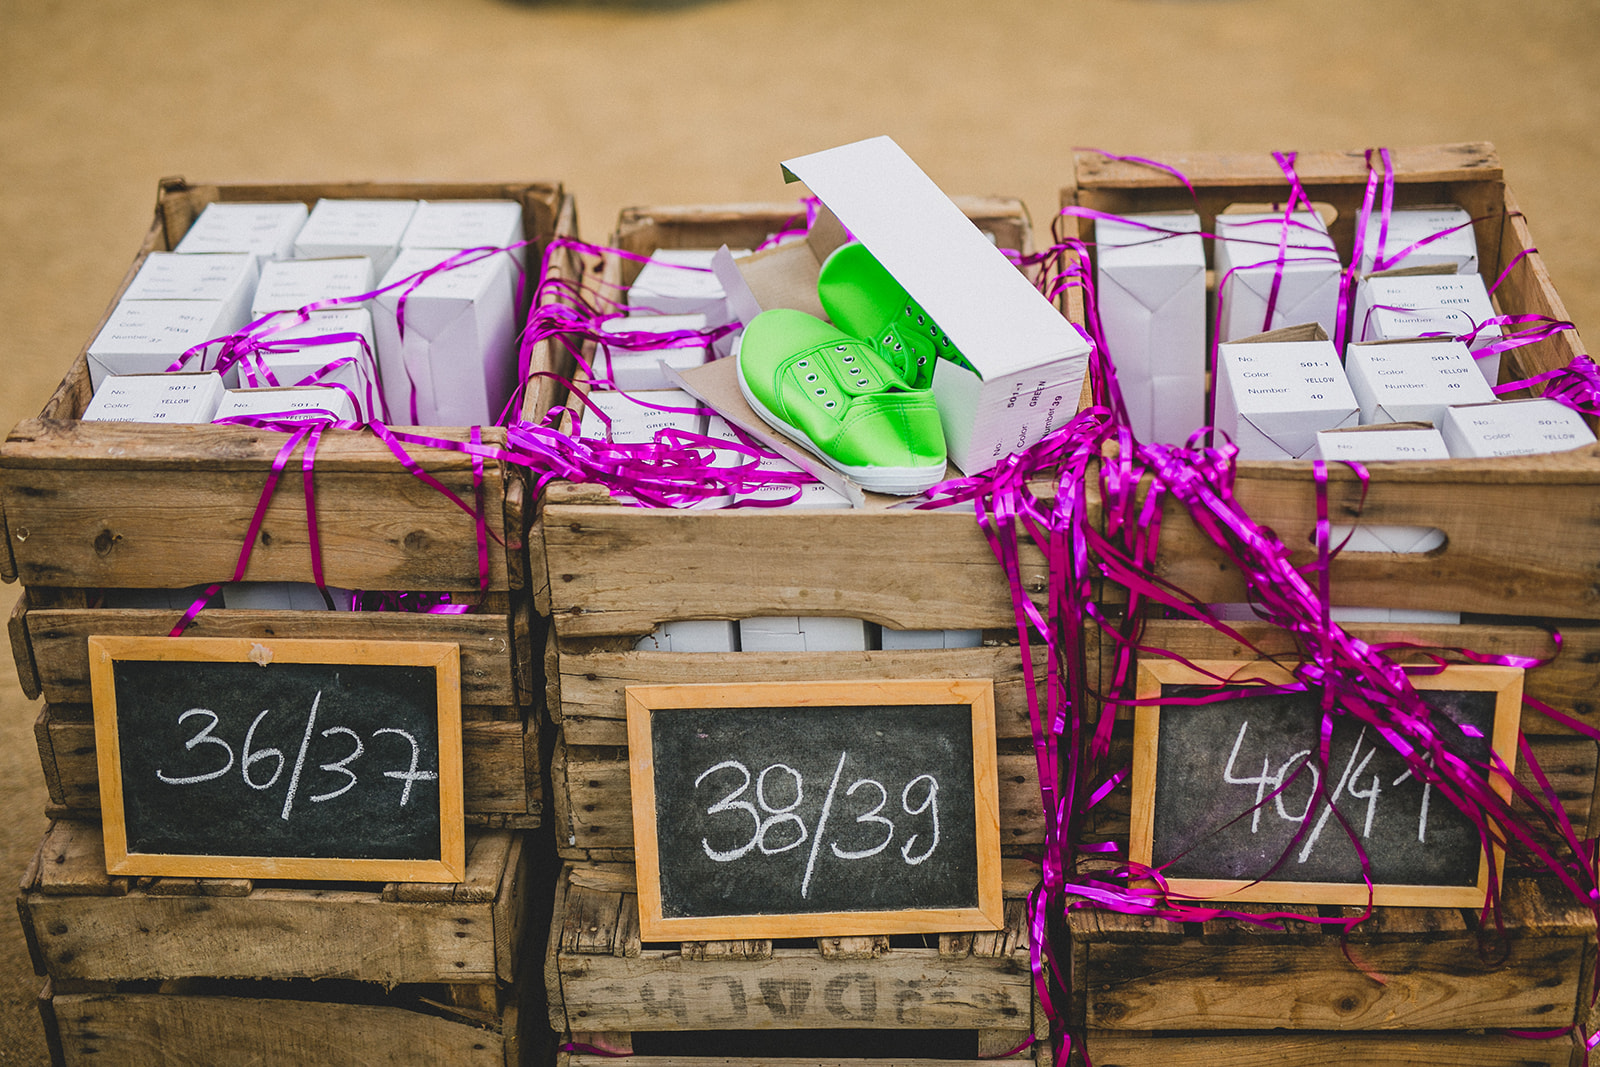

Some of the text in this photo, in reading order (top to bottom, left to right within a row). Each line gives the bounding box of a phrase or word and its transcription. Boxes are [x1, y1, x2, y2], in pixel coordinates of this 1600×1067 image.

[1007, 382, 1023, 408] 501-1
[1029, 381, 1046, 407] GREEN
[1052, 395, 1062, 406] 39
[156, 690, 438, 820] 36/37
[1223, 721, 1436, 864] 40/41
[694, 751, 941, 900] 38/39
